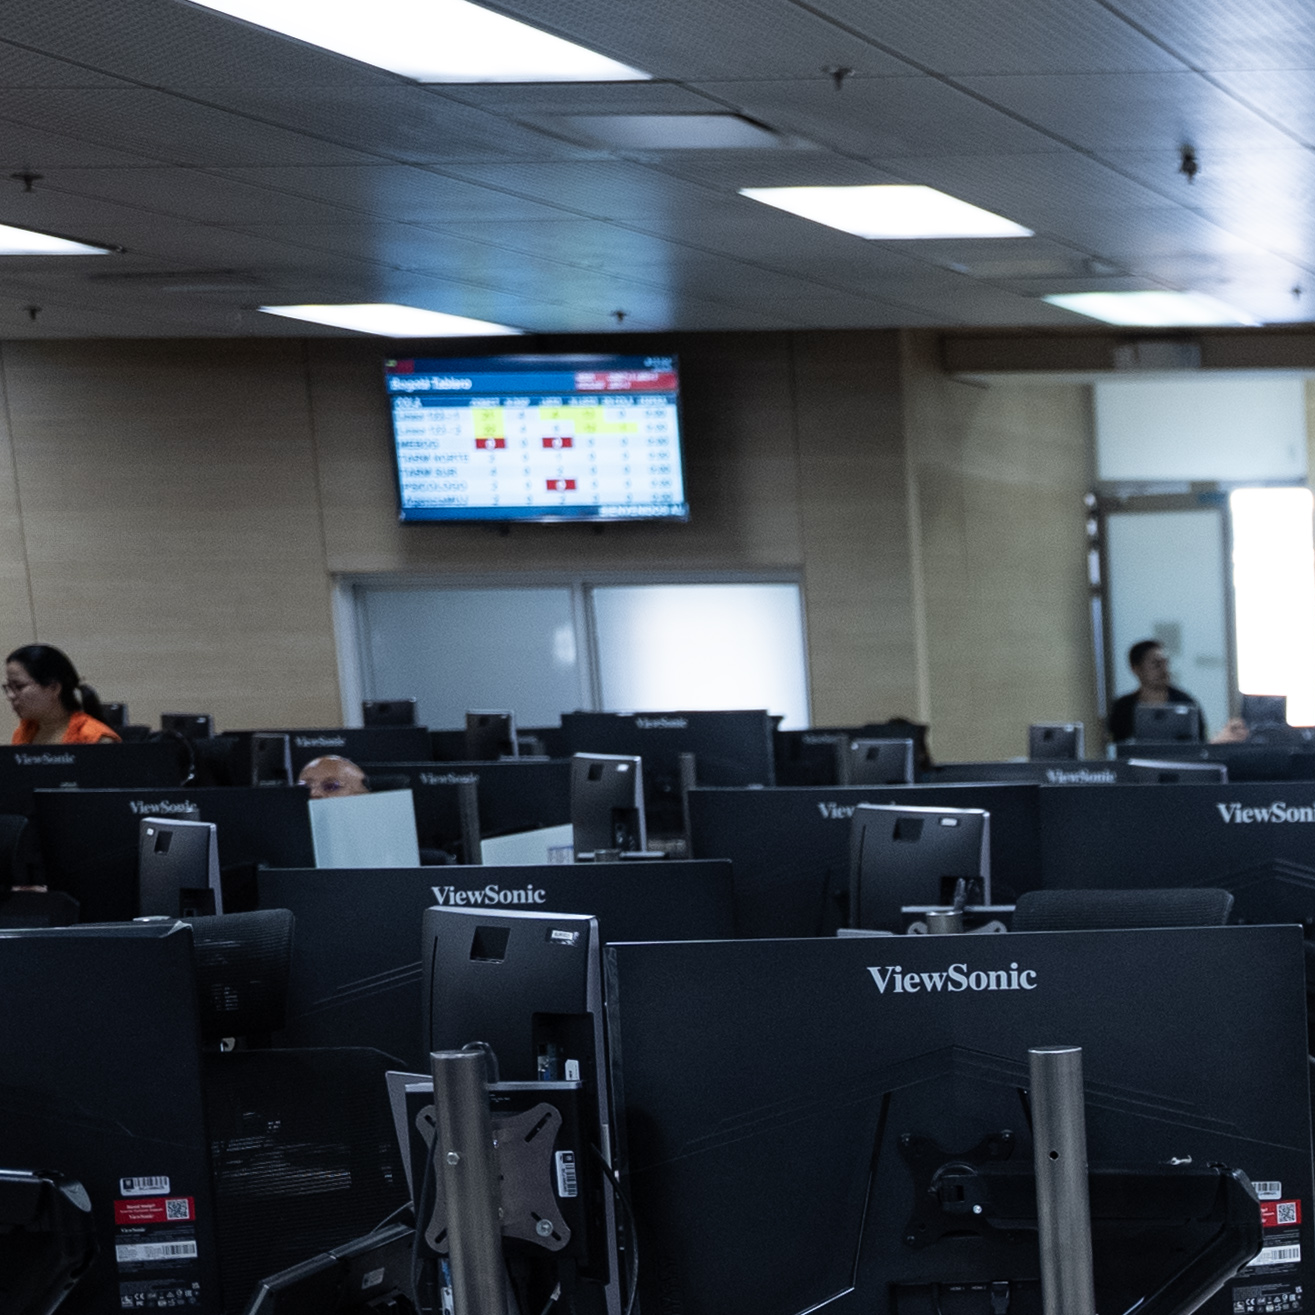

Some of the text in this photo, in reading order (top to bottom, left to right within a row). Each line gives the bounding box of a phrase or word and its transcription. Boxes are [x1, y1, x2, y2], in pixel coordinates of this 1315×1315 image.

[295, 736, 346, 748] ViewSonic
[15, 753, 75, 765] ViewSonic
[1046, 769, 1116, 785] ViewSonic
[130, 800, 197, 815] ViewSonic
[431, 885, 546, 906] ViewSonic
[867, 961, 1038, 993] ViewSonic
